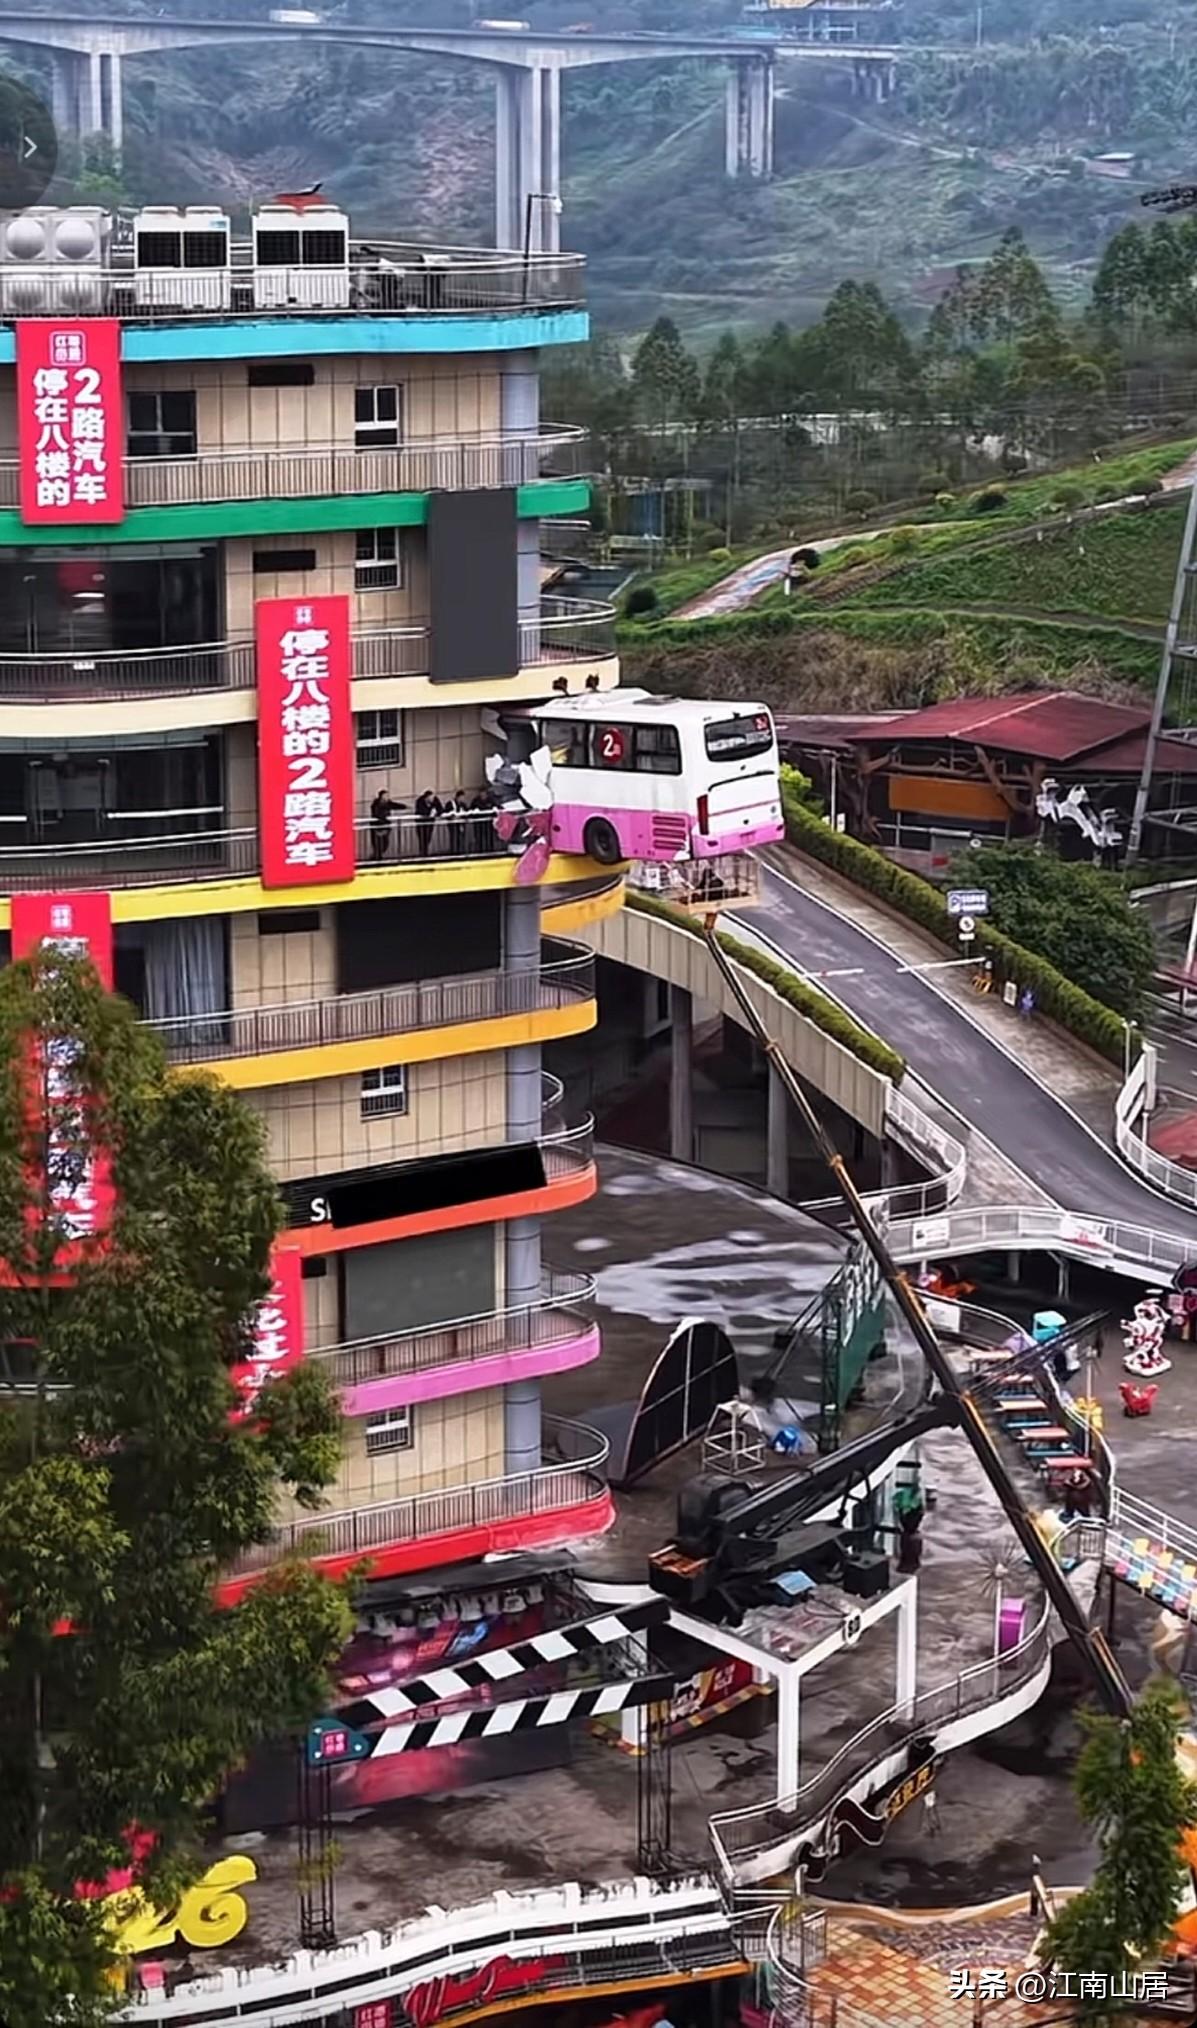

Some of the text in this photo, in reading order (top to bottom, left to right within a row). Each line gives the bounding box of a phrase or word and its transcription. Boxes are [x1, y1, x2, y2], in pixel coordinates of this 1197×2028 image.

[33, 368, 71, 507] 停在八楼的
[73, 367, 108, 505] 2路汽车
[279, 629, 334, 867] 停在八楼的2路汽车
[311, 1197, 332, 1222] S
